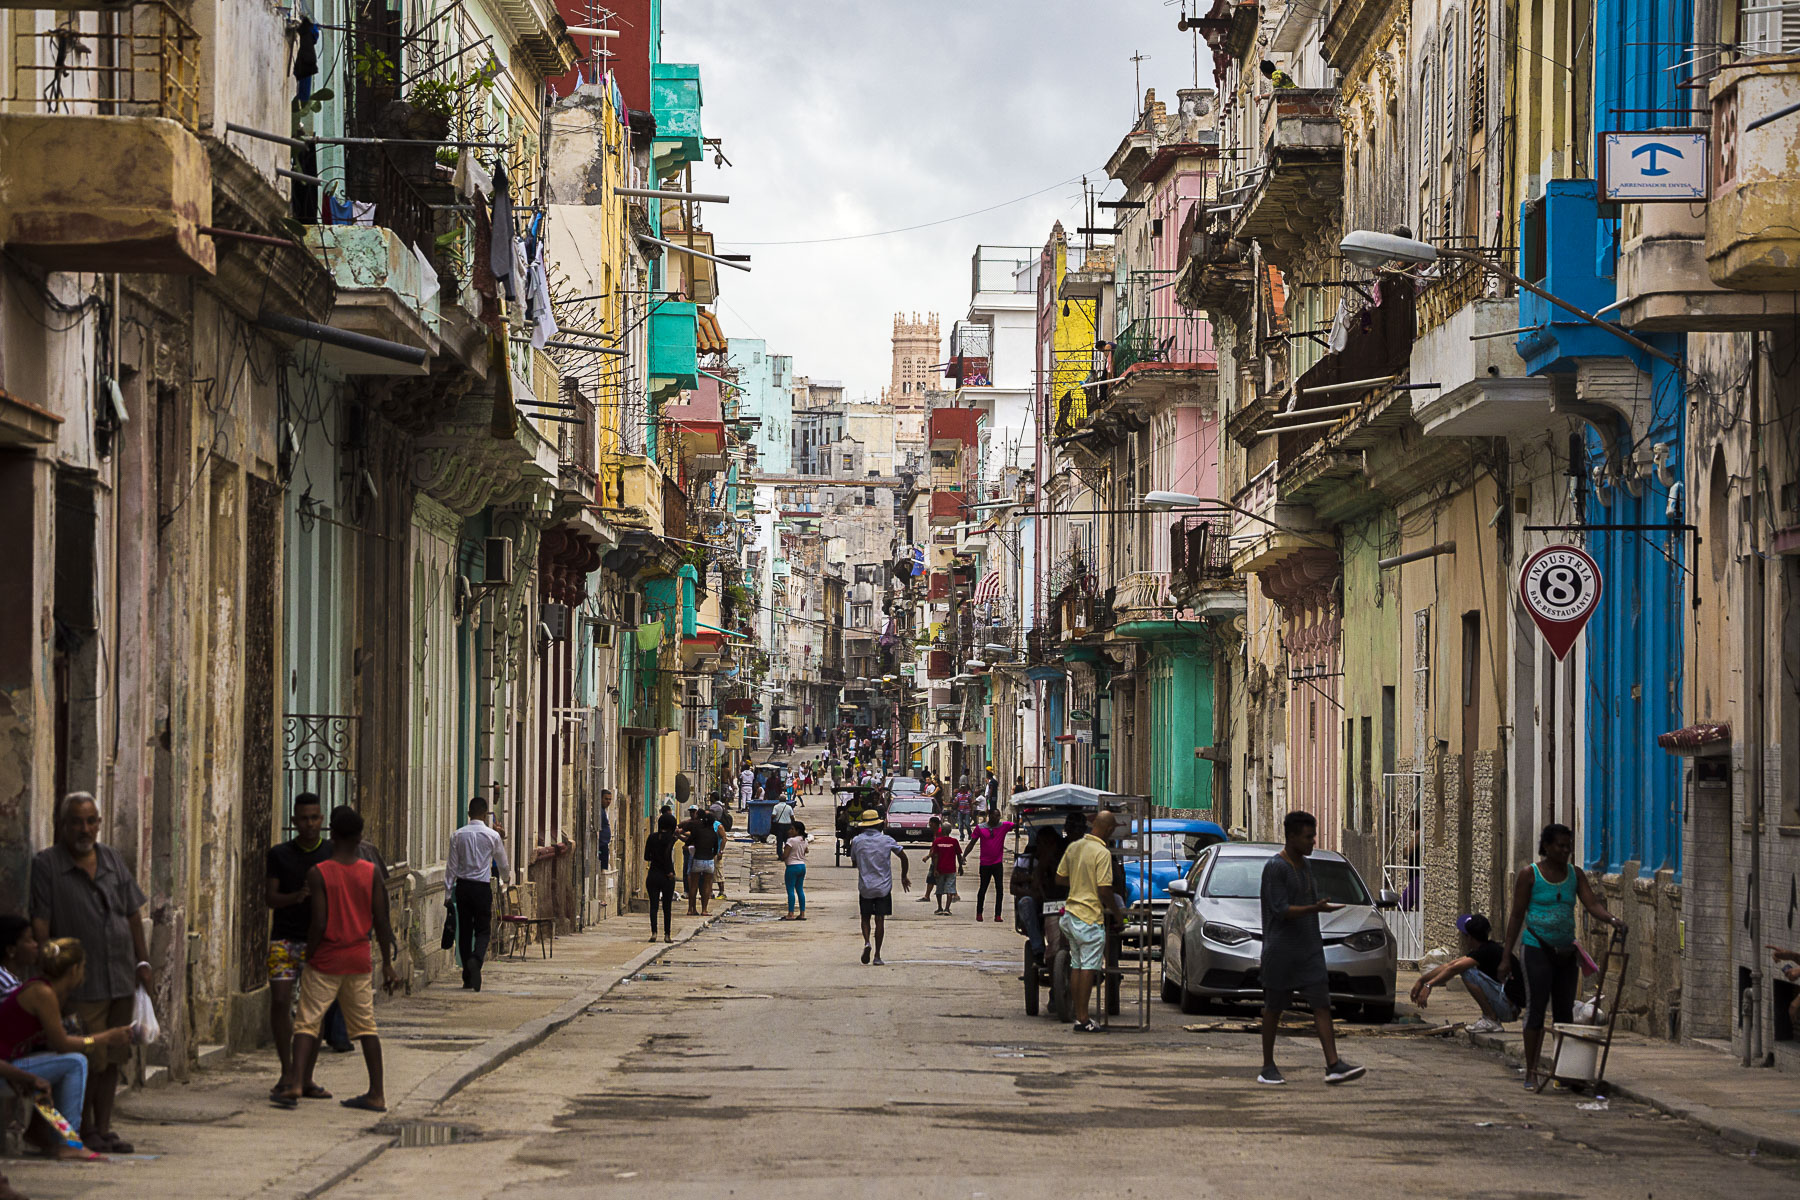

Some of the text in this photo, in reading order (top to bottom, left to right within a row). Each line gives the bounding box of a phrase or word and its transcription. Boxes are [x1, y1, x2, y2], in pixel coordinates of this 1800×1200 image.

[1530, 554, 1592, 583] INDUSTRIA
[1546, 567, 1576, 604] 8
[1530, 590, 1592, 617] BAR-RESTAURANTE
